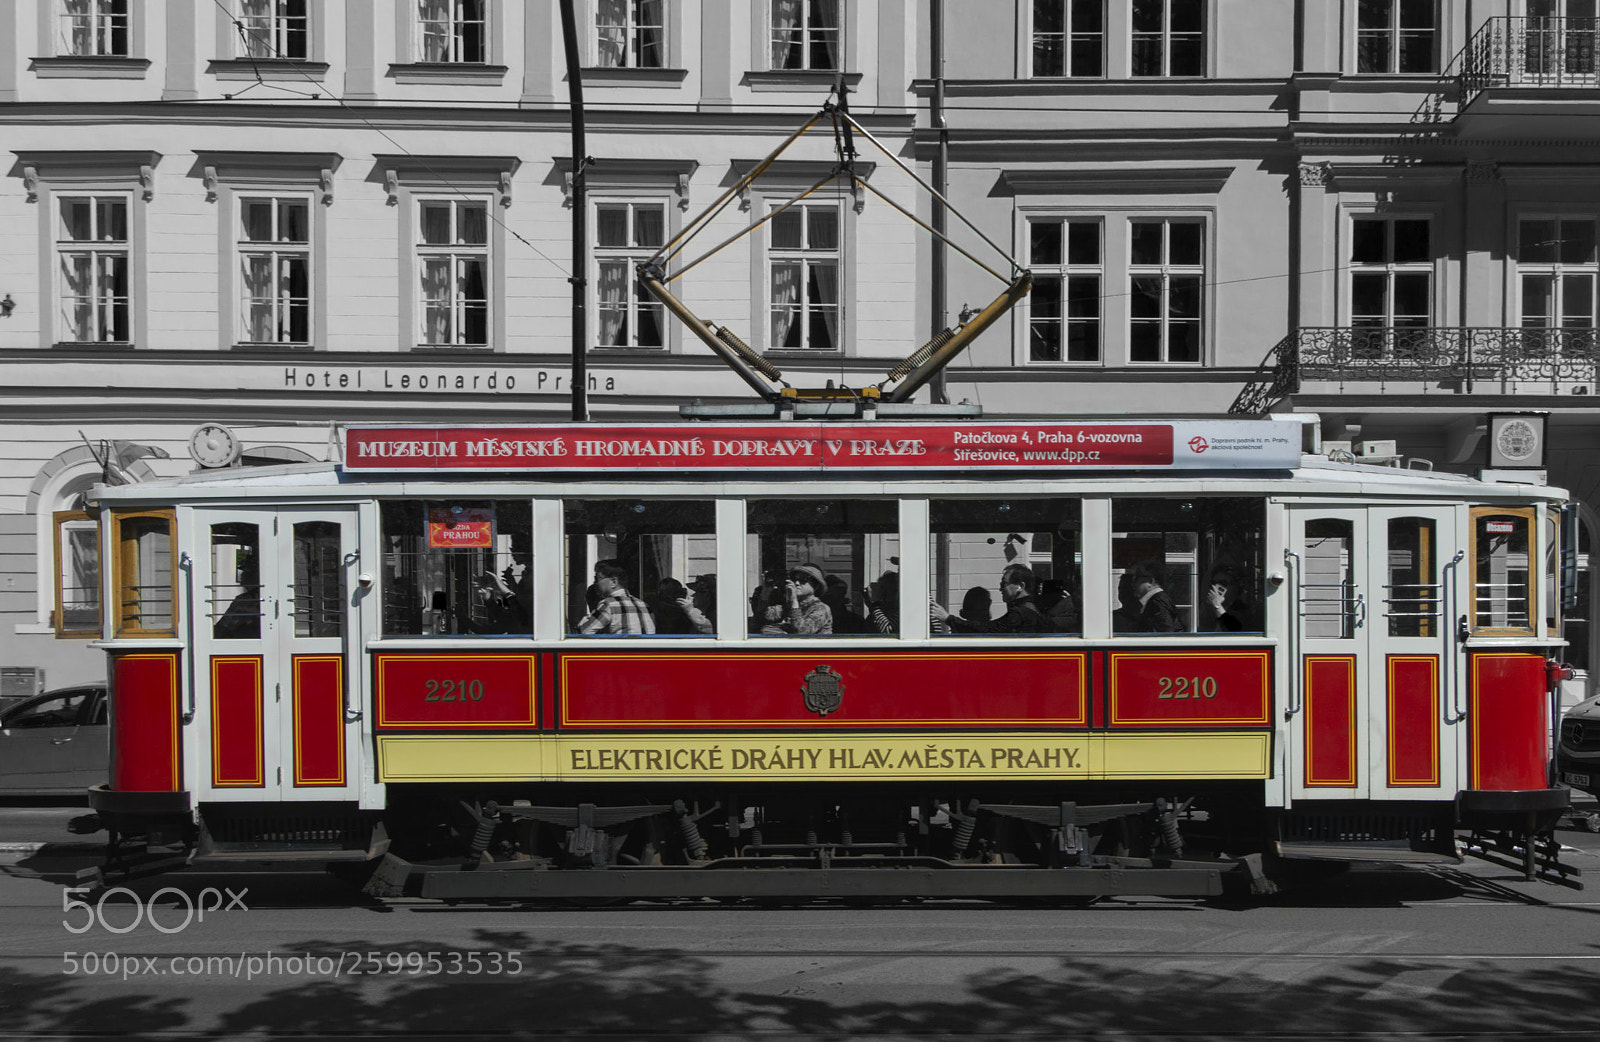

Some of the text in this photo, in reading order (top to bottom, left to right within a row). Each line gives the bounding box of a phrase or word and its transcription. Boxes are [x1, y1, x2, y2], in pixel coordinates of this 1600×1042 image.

[285, 368, 615, 390] Hotel Leonardo Prha
[357, 437, 927, 457] MUZEUM MĚSTSKÉ HROMADNÉ DOPRAVY V PRAZE
[954, 431, 1143, 445] Patočkova 4, Praha 6-vozovna
[954, 448, 1101, 463] Střešovice, www.dpp.cz
[443, 531, 480, 540] PRAHOU
[425, 679, 485, 702] 2210
[1158, 676, 1218, 699] 2210
[571, 744, 1082, 770] ELEKTRICKÉ DRÁHY HLAV. MĚSTA PRAHY.
